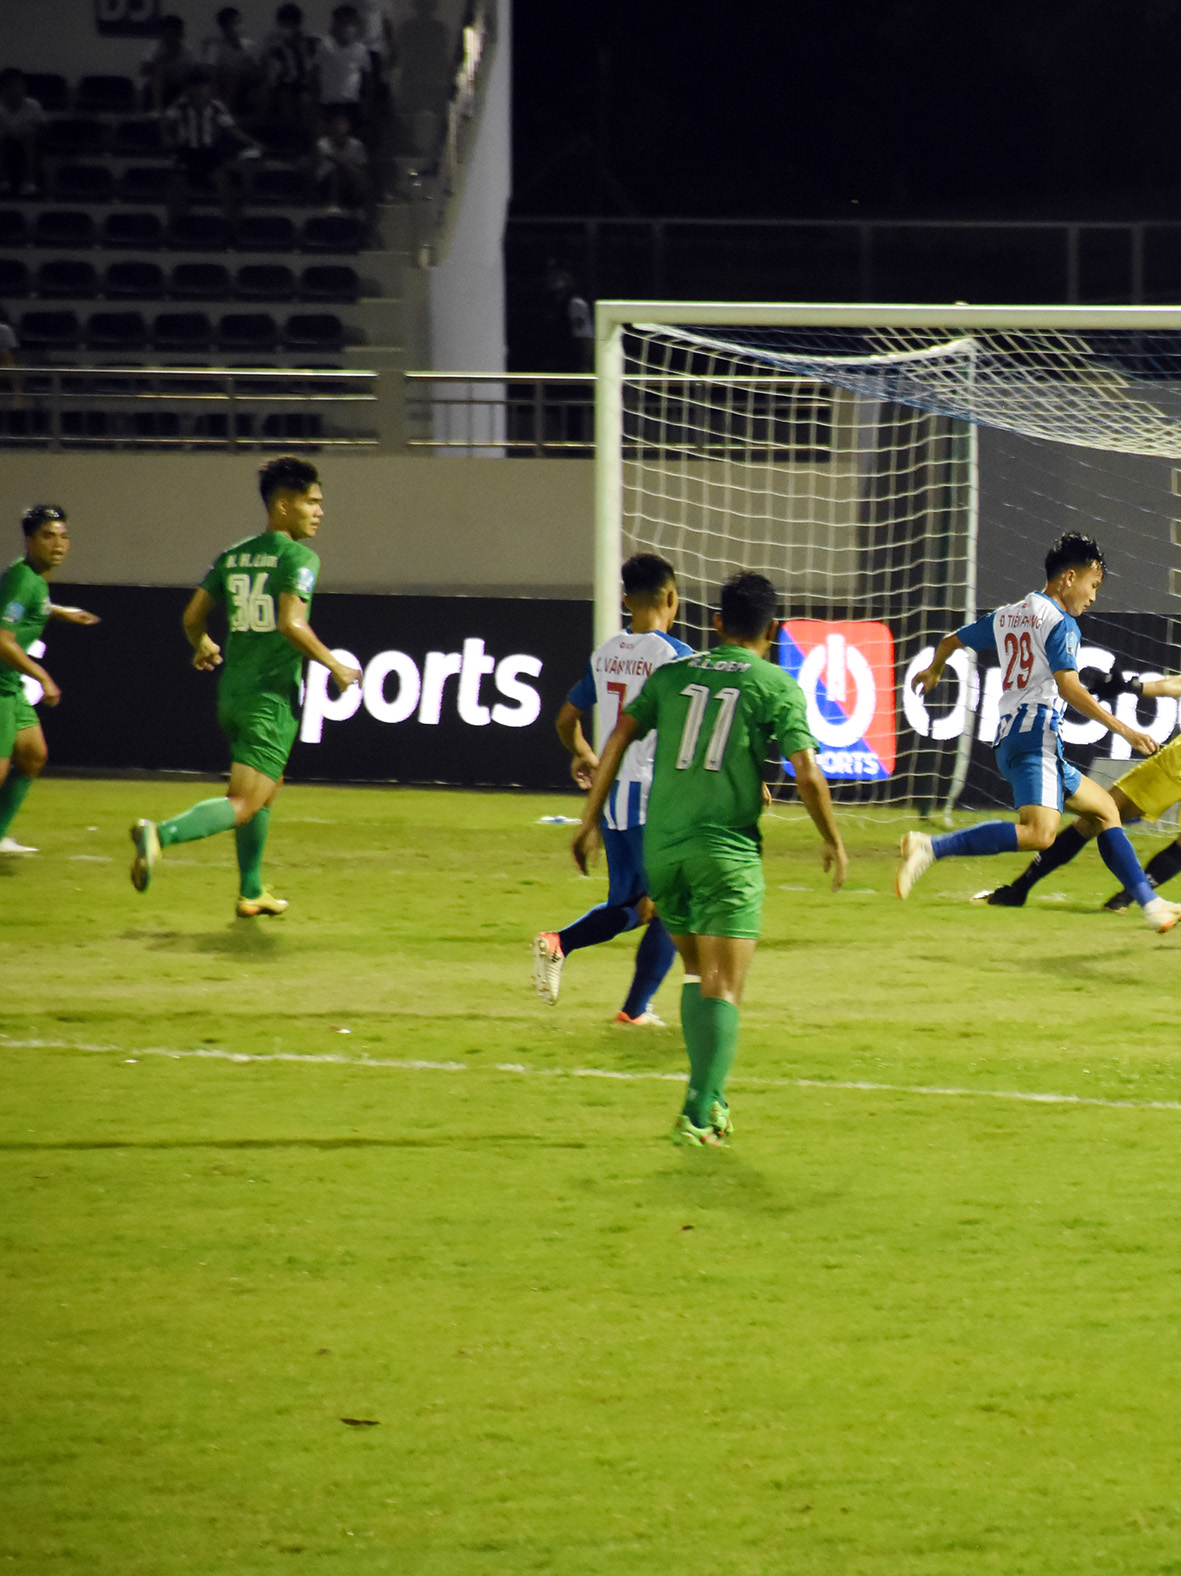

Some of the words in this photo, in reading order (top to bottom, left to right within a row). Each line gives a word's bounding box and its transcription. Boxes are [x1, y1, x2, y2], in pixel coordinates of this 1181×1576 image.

[227, 572, 277, 632] 36
[299, 638, 543, 743] ports
[1003, 632, 1034, 690] 29
[607, 681, 627, 730] 7
[676, 683, 740, 771] 11
[816, 752, 880, 775] ORTS
